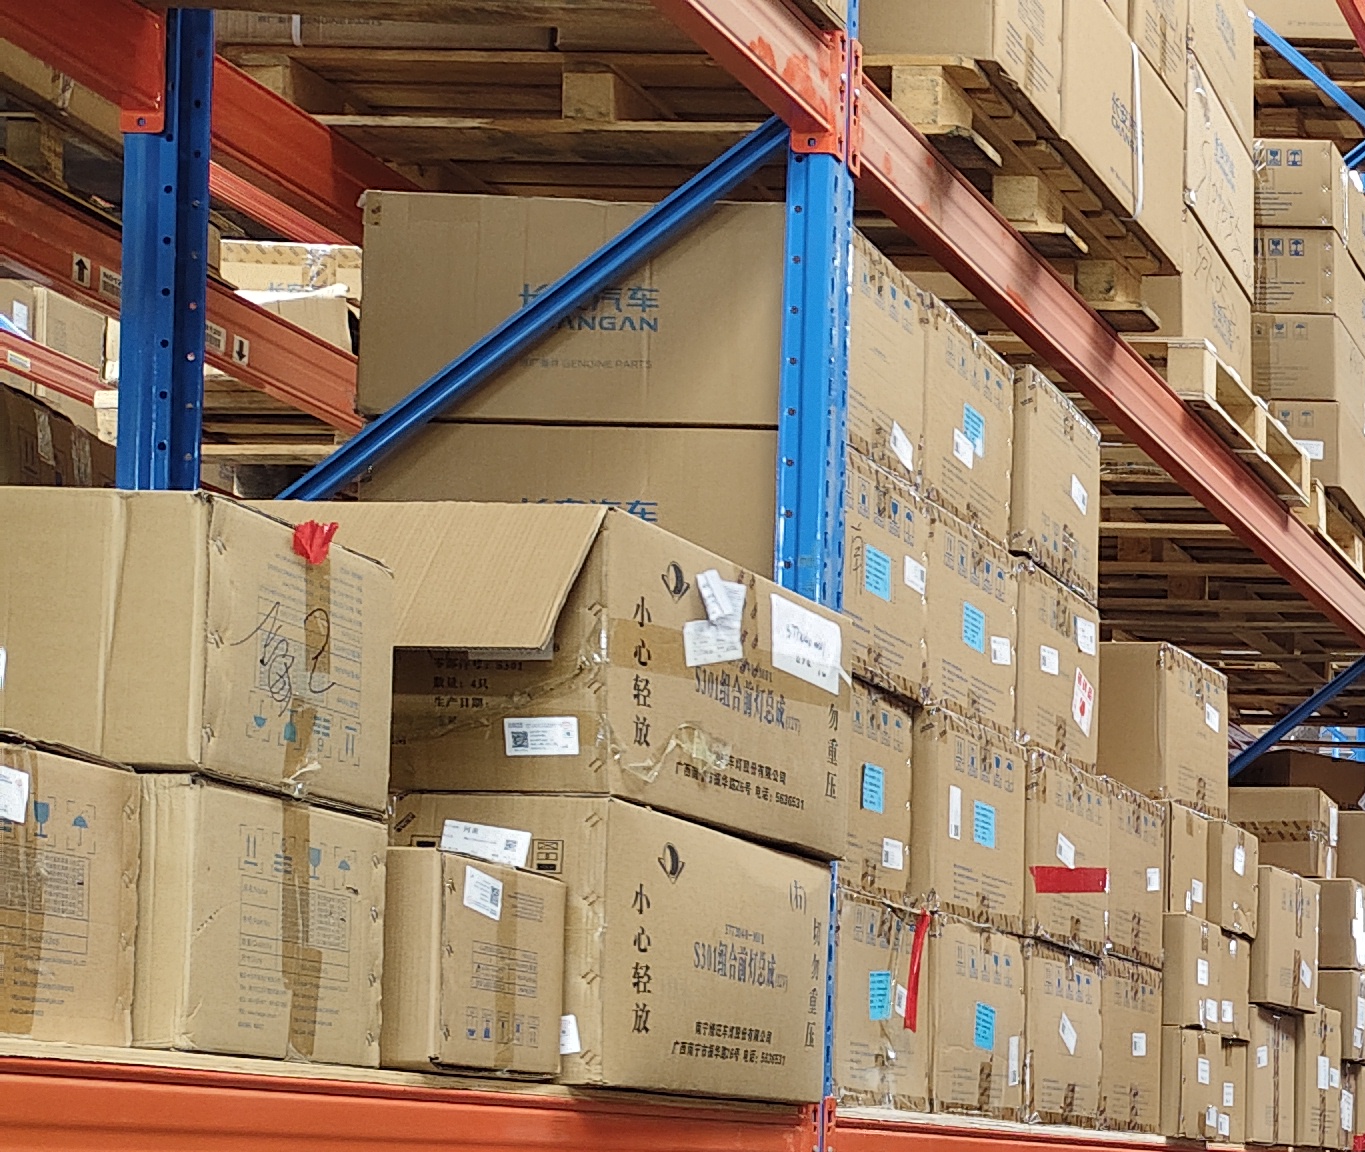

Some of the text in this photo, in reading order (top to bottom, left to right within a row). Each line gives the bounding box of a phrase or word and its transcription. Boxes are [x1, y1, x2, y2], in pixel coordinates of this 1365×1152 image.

[555, 315, 659, 333] ANGAN
[632, 595, 653, 750] 小心轻放
[824, 702, 840, 800] 勿重压
[632, 881, 652, 1035] 小心轻放
